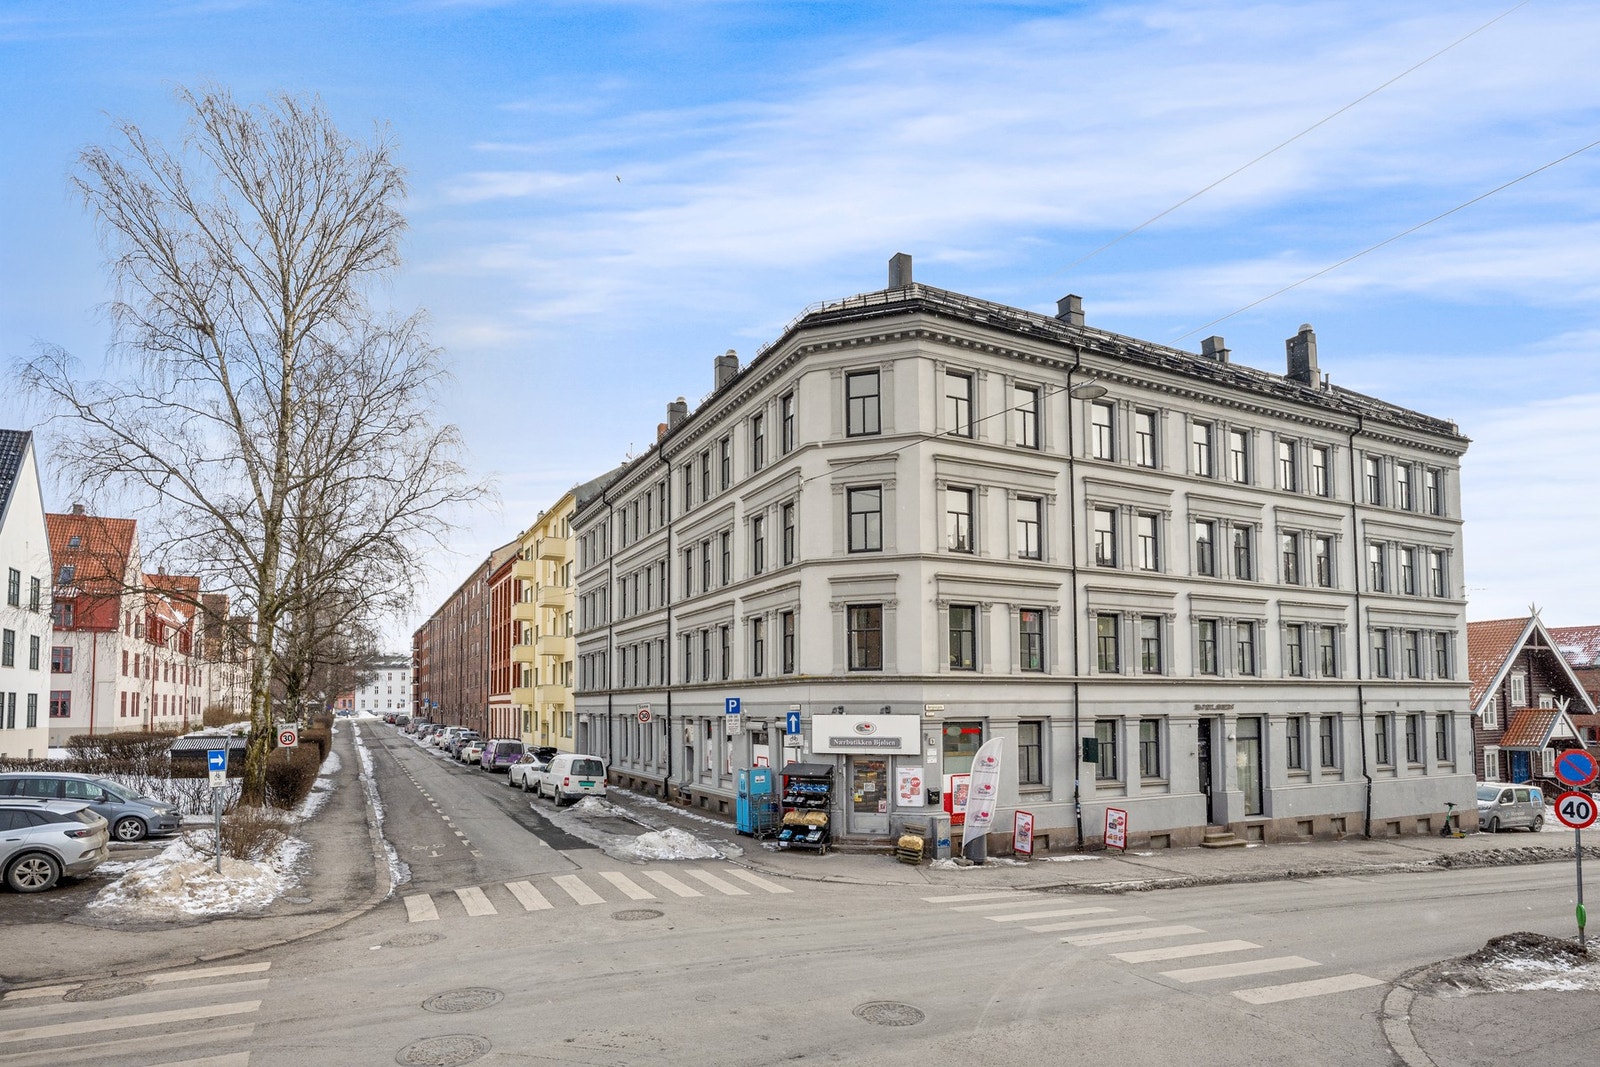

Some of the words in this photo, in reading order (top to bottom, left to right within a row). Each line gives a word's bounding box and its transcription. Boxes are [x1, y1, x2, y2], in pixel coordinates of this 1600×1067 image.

[729, 700, 737, 712] P
[282, 734, 293, 742] 30
[834, 738, 872, 746] Nærbutikken
[873, 738, 896, 747] Bjølsen
[1562, 801, 1590, 820] 40
